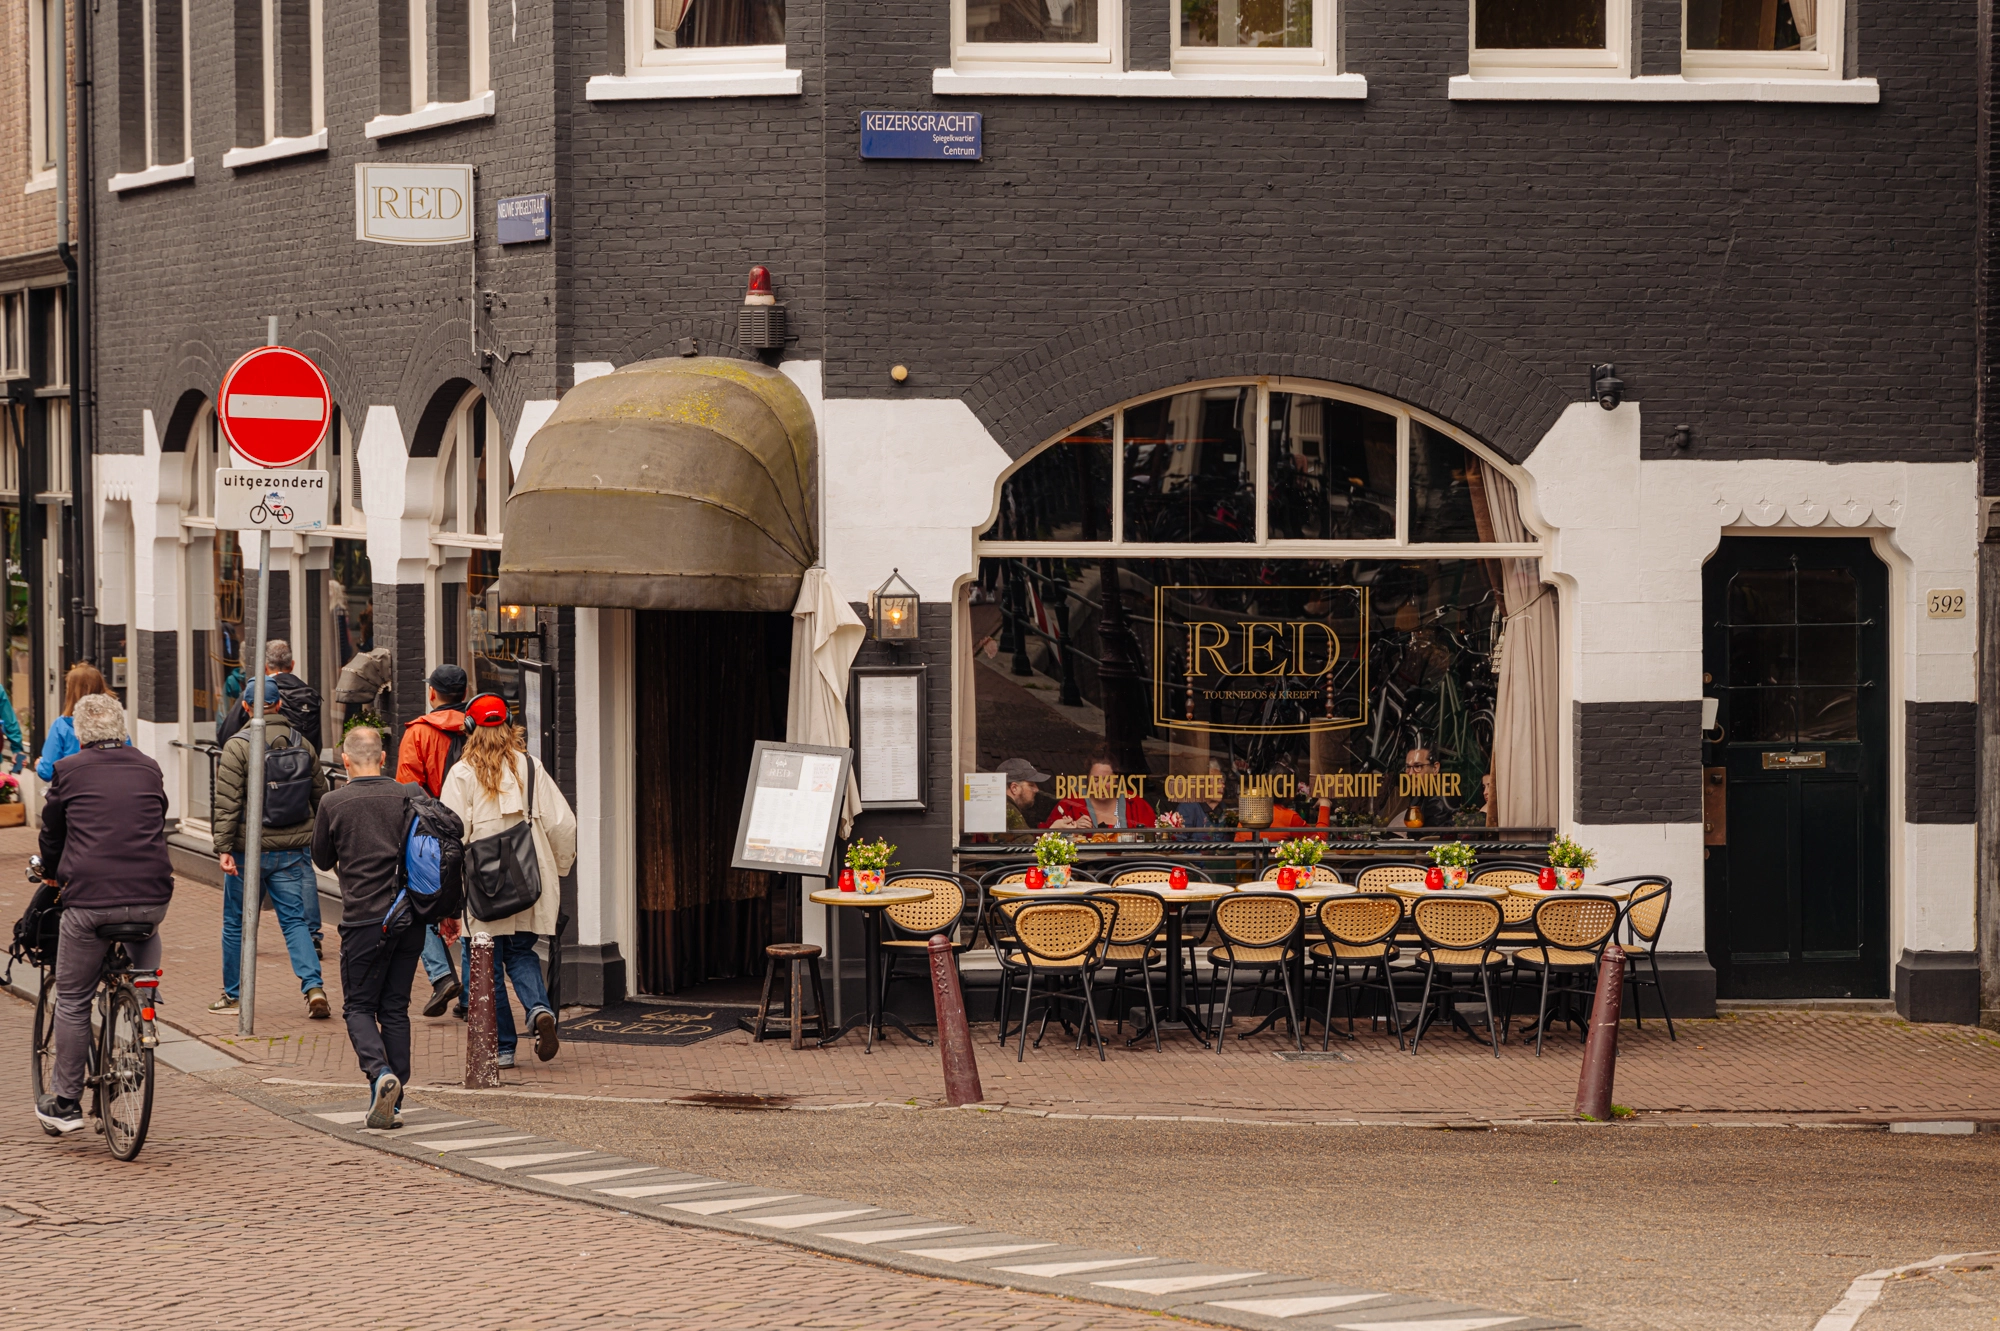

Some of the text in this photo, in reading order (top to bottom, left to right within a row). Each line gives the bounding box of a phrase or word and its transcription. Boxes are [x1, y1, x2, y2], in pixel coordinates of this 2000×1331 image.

[866, 114, 975, 132] KEIZERSGRACHT
[932, 133, 975, 144] Spiegelkwartier
[943, 145, 976, 156] Centrum
[371, 186, 463, 220] RED
[498, 197, 546, 219] NIEUWE SPIEGELSTRAAT
[224, 475, 324, 491] uitgezonderd
[1929, 595, 1964, 614] 592
[1183, 621, 1341, 677] RED
[1203, 689, 1320, 700] TOURNEDOS & KREEFT
[1055, 767, 1462, 799] BREAKFAST COFFEE LUNCH APÉRITIF DINNER
[561, 1018, 713, 1036] RED
